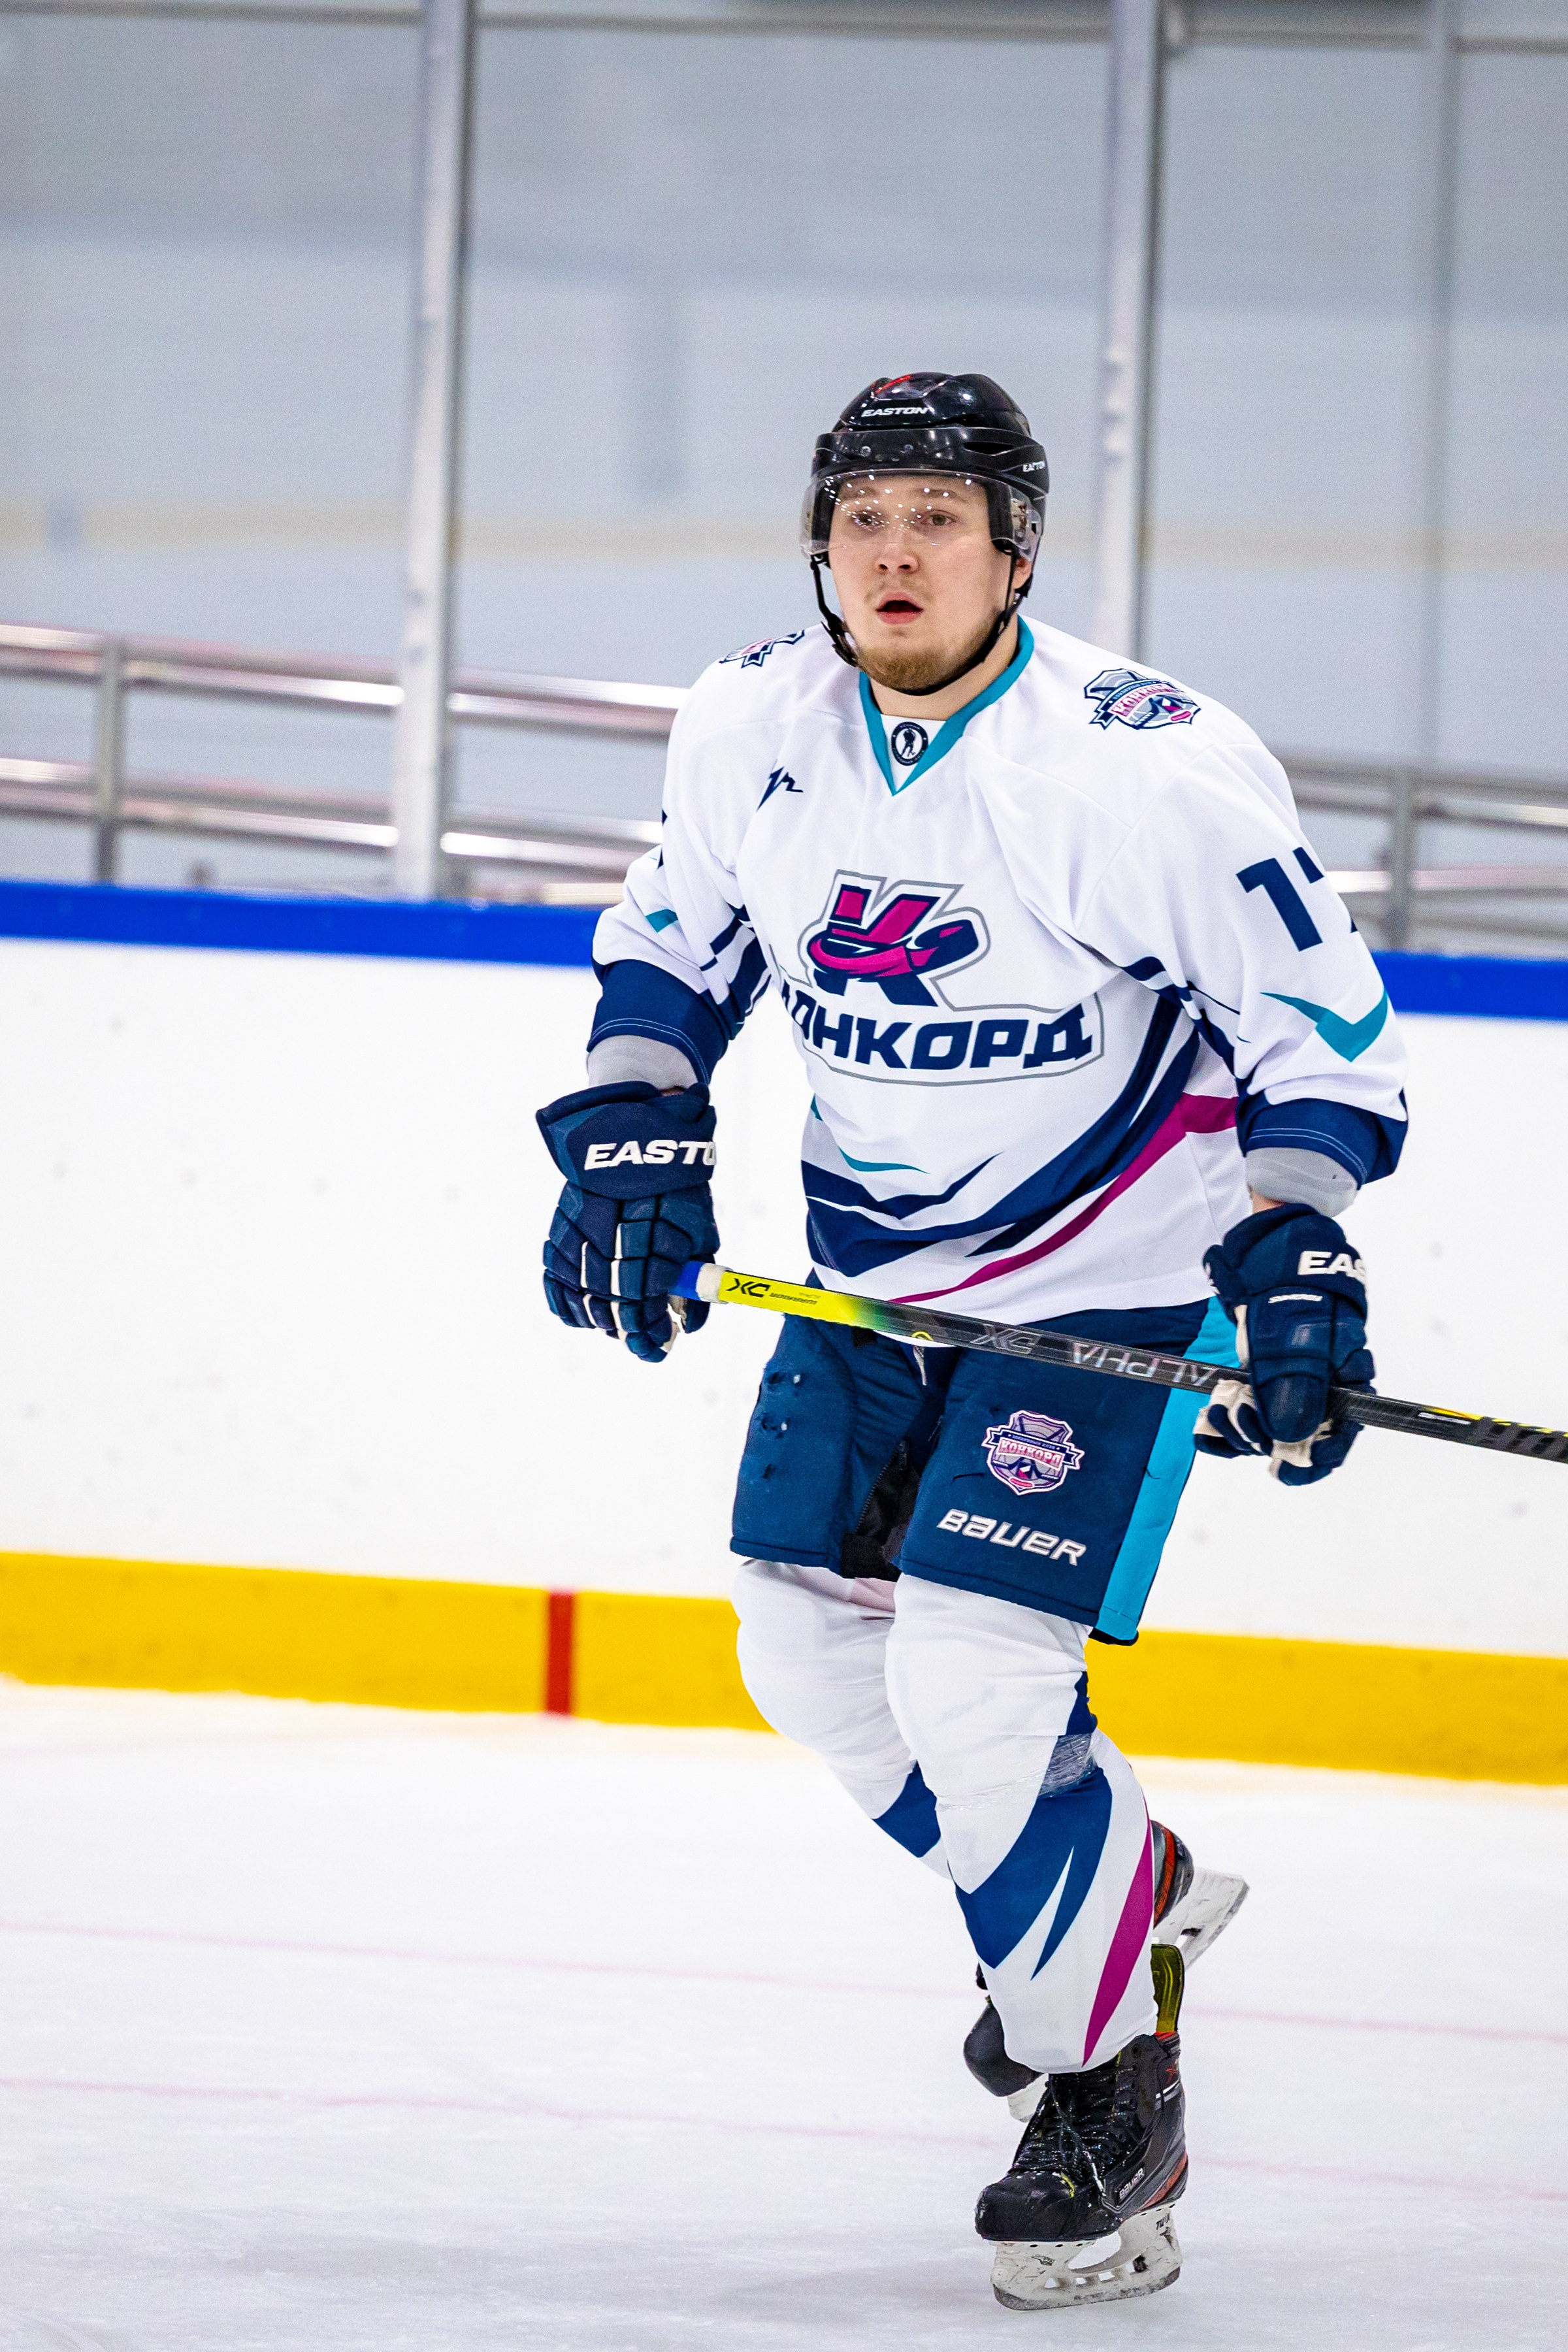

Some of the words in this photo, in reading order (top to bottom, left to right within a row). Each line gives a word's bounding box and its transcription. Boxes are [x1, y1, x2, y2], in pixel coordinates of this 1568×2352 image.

[860, 406, 928, 417] EASTON
[769, 1292, 818, 1305] WARRIOR
[1072, 1342, 1220, 1386] ALPHA
[1000, 1439, 1062, 1464] КОНКОРД
[936, 1509, 1087, 1566] BAUER
[1119, 2168, 1145, 2200] BAUER
